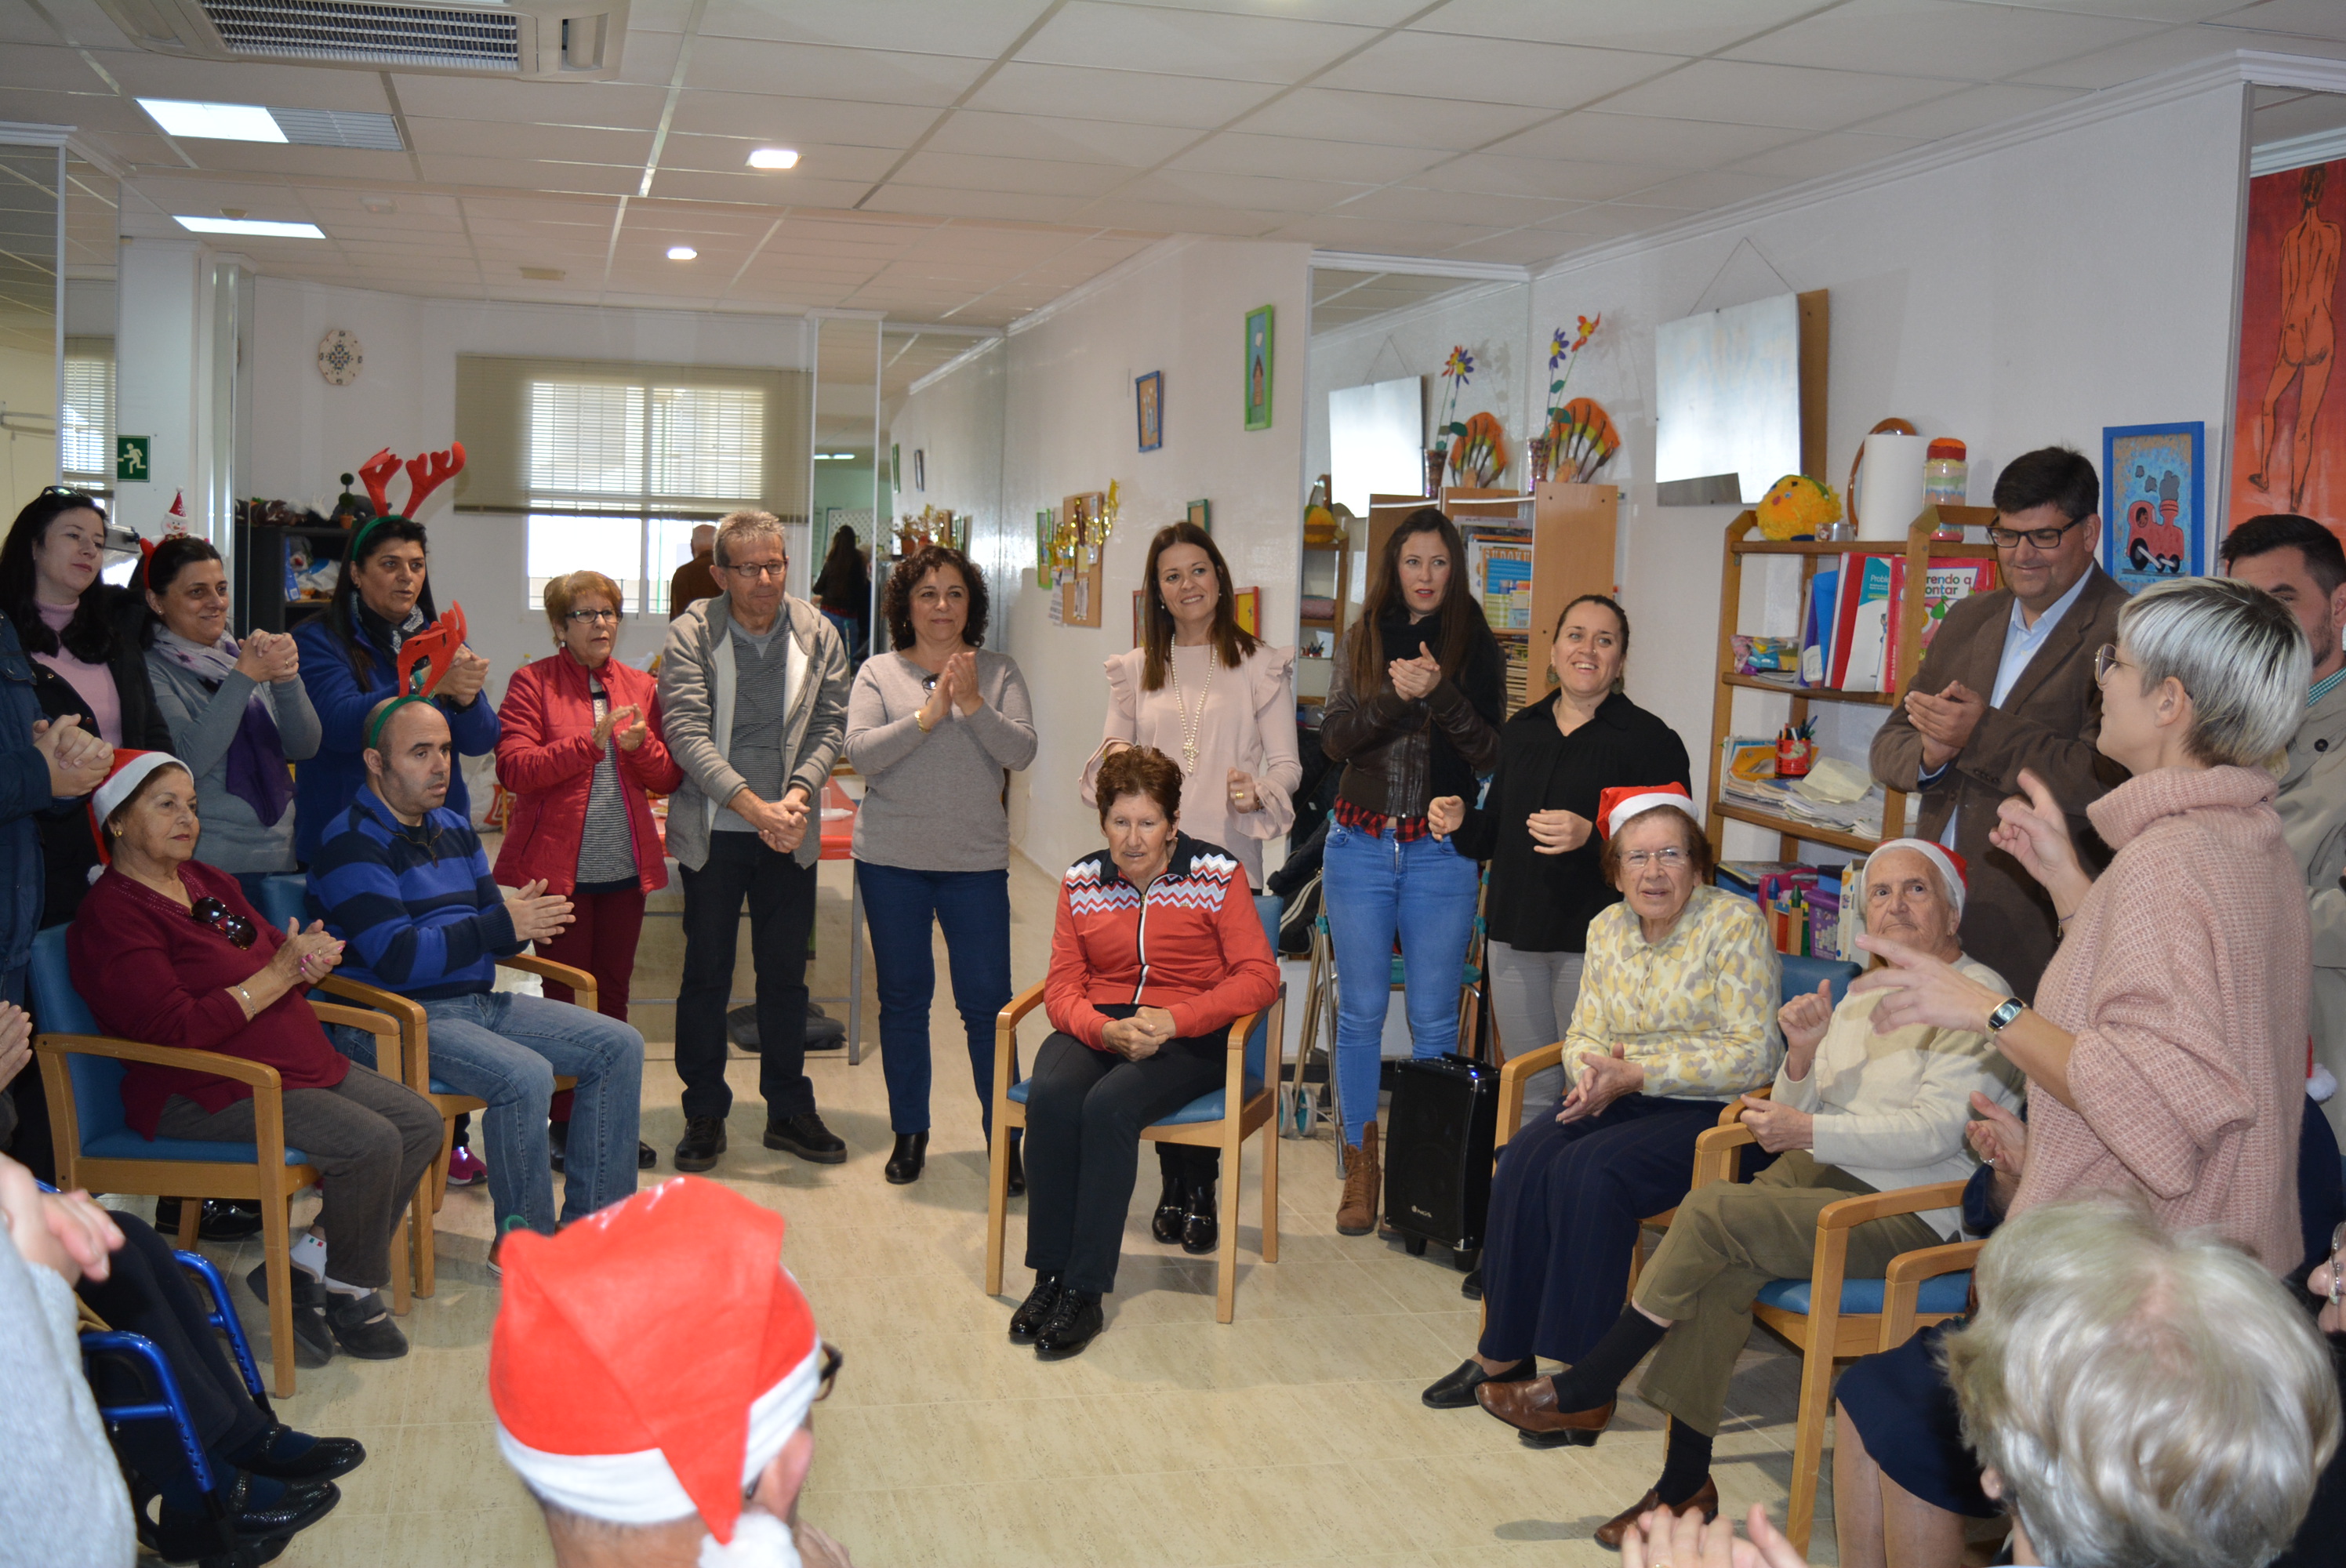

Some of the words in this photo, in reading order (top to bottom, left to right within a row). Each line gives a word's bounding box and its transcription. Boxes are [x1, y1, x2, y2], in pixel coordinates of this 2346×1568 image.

[1485, 550, 1531, 562] SUDOKU
[1927, 573, 1960, 584] rendo
[1963, 576, 1972, 585] a
[1925, 585, 1959, 595] ontar
